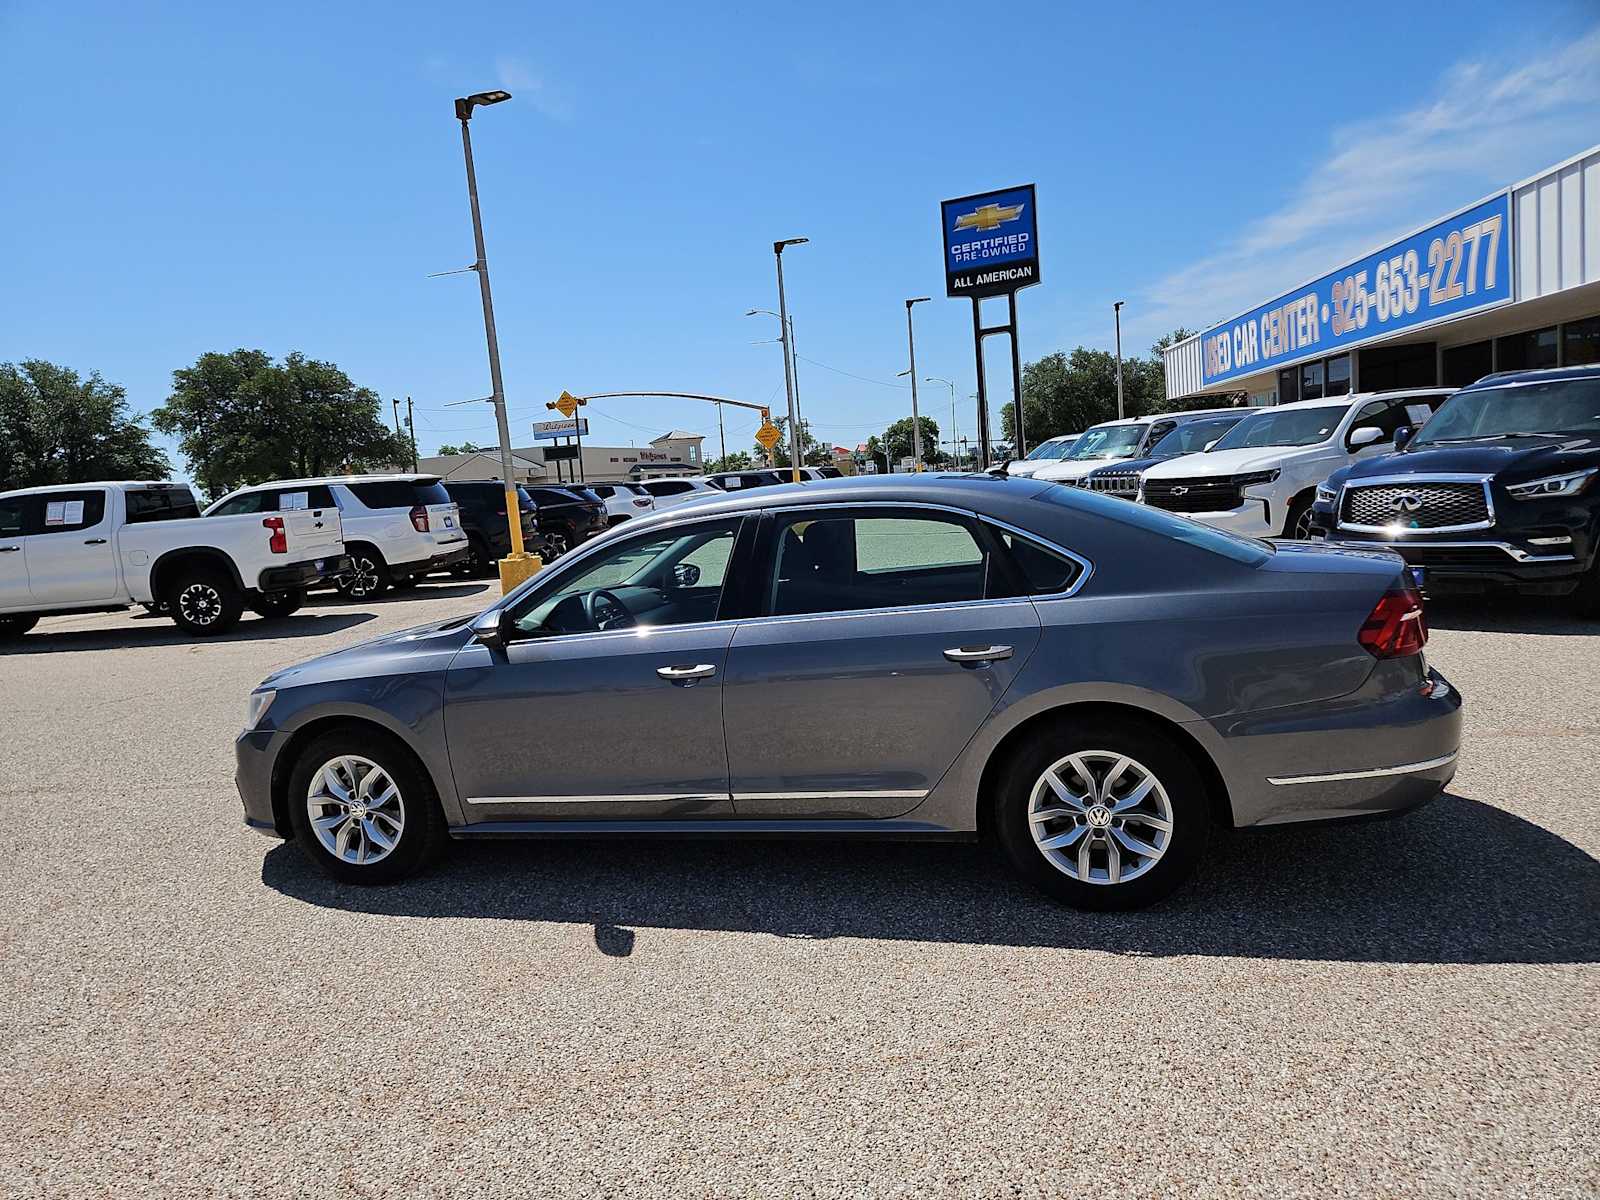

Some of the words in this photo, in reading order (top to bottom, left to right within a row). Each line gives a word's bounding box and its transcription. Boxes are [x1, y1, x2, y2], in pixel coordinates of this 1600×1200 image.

[951, 233, 1029, 254] CERTIFIED
[955, 243, 1026, 262] PRE-OWNED
[954, 278, 973, 288] ALL
[976, 266, 1032, 285] AMERICAN
[1204, 331, 1232, 378] USED
[1233, 318, 1260, 369] CAR
[1261, 292, 1321, 361] CENTER
[1331, 214, 1502, 336] 325-653-2277
